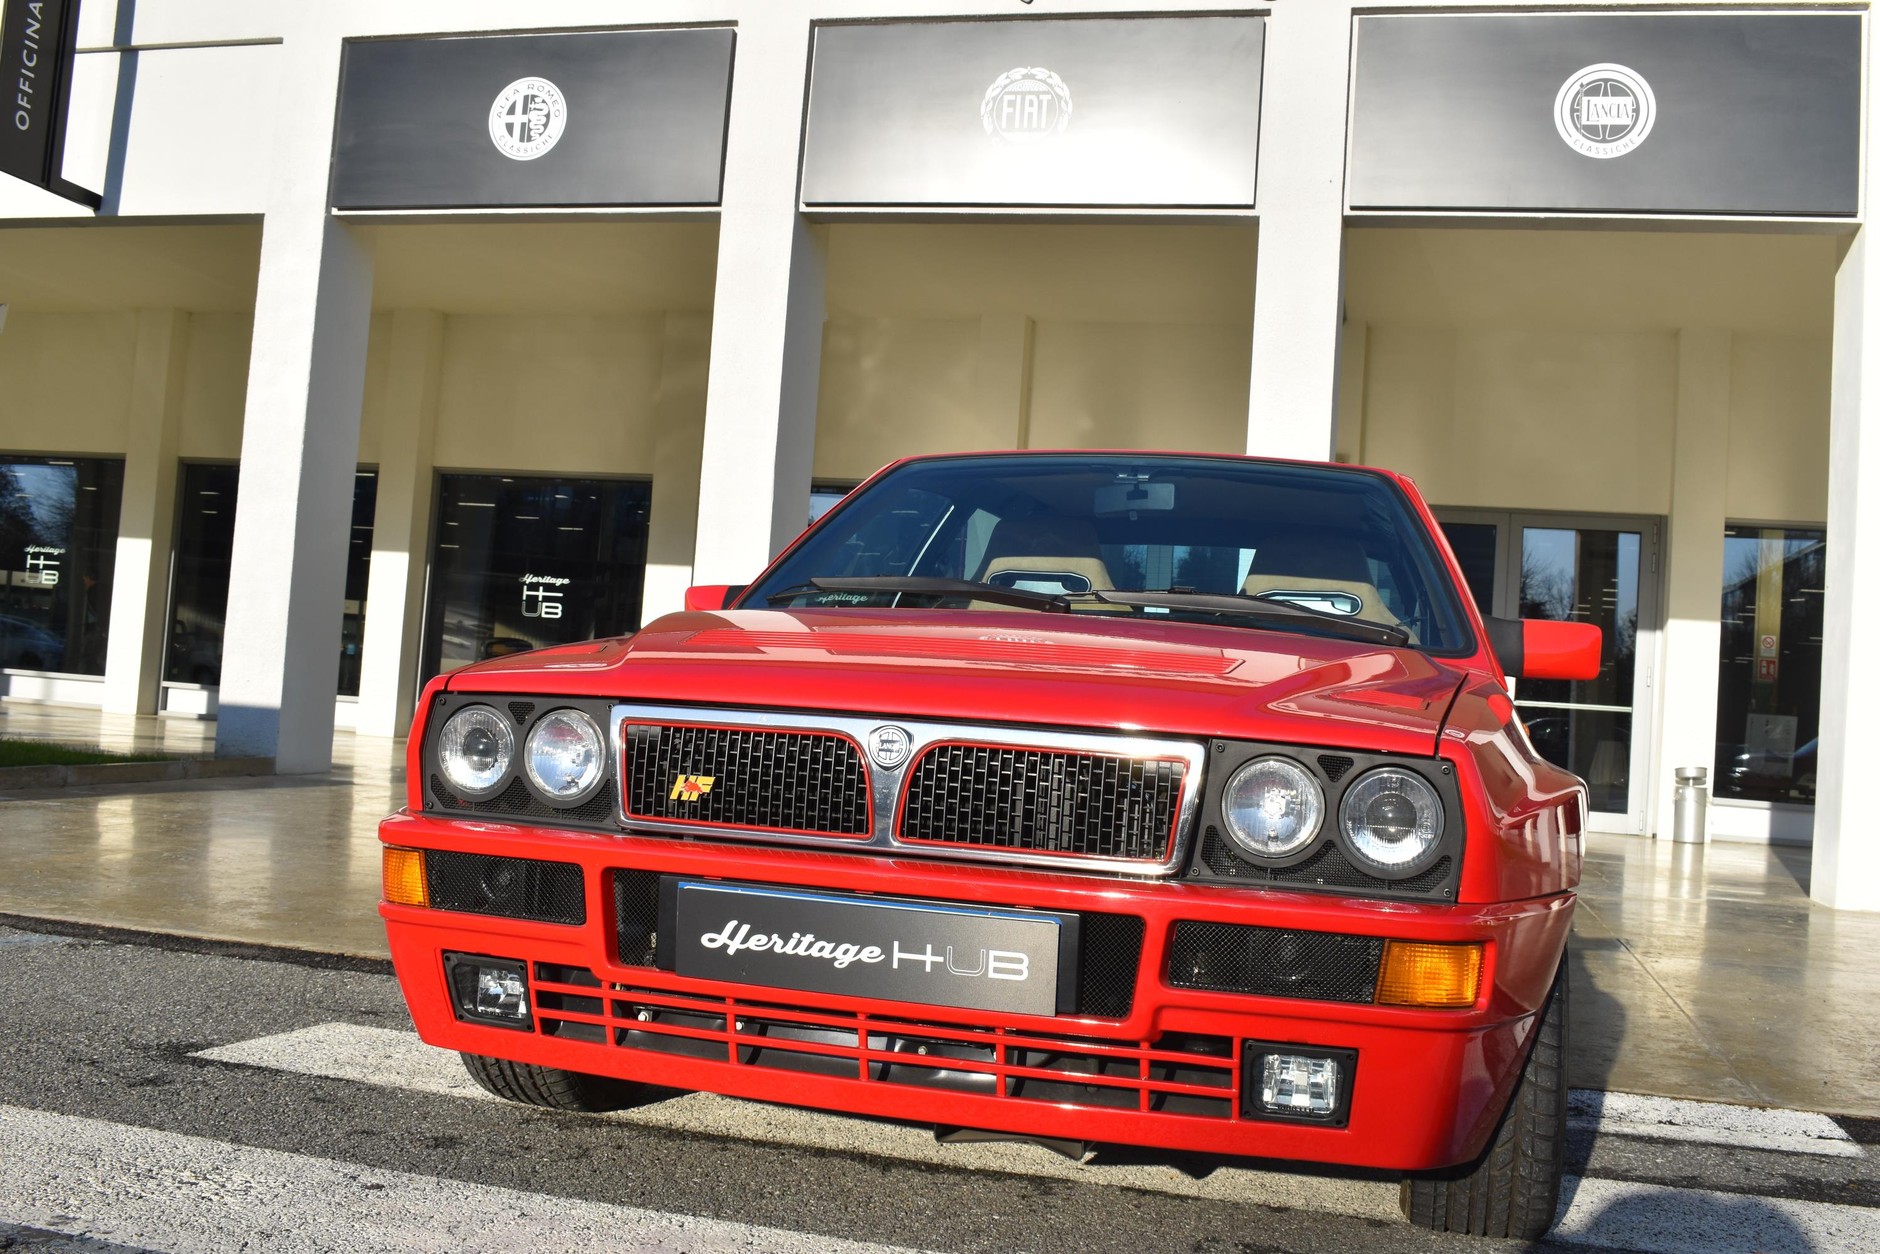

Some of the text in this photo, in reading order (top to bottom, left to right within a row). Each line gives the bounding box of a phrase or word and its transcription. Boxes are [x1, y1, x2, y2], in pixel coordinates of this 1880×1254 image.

[14, 2, 43, 131] OFFICINA
[496, 83, 561, 119] ALFA ROMEO
[1001, 94, 1052, 129] FIAT
[1586, 99, 1630, 122] LANCIA
[1573, 138, 1636, 155] CLASSICHE
[24, 544, 66, 555] Heritage
[518, 573, 570, 586] Heritage
[701, 920, 1029, 981] Heritage HUB
